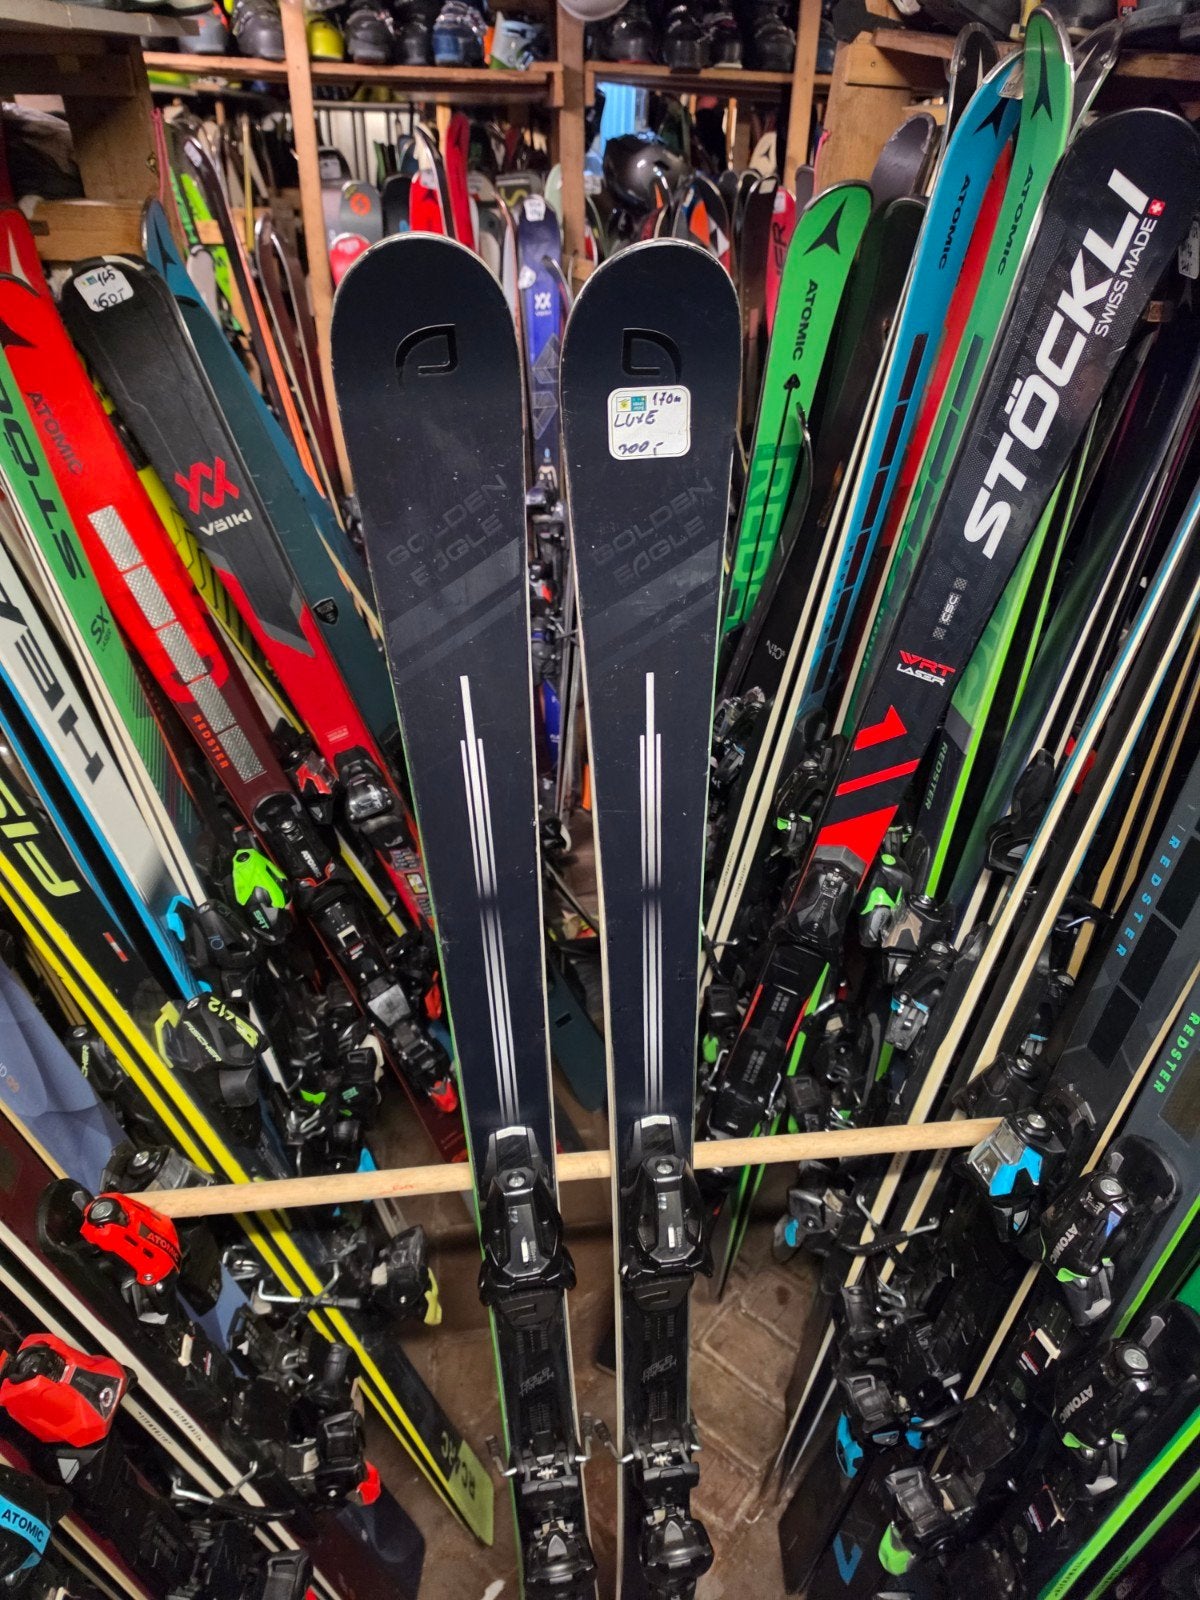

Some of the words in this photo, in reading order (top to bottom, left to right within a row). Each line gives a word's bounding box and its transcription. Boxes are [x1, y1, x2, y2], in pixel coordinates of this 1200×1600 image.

[938, 174, 971, 270] ATOMIC
[998, 164, 1034, 276] ATOMIC
[1094, 279, 1130, 338] SWISS
[1119, 216, 1158, 279] MADE
[792, 278, 819, 362] ATOMIC
[964, 168, 1150, 560] STÖCKLI
[26, 391, 83, 475] ATOMIC
[614, 409, 659, 428] LUXE
[591, 476, 714, 565] GOLDEN
[612, 514, 706, 583] EAGLE
[91, 605, 109, 646] SX
[896, 663, 946, 686] LASER
[900, 650, 956, 677] WRT
[192, 714, 230, 769] REDSTER
[925, 741, 949, 811] REDSTER
[300, 850, 323, 878] ATOMIC
[1116, 834, 1181, 957] REDSTER
[183, 1021, 223, 1062] FISCHER
[1153, 1011, 1200, 1094] REDSTER
[146, 1232, 180, 1263] ATOMIC
[1050, 1222, 1079, 1266] ATOMIC
[1059, 1384, 1094, 1424] ATOMIC
[1, 1508, 45, 1543] ATOMIC
